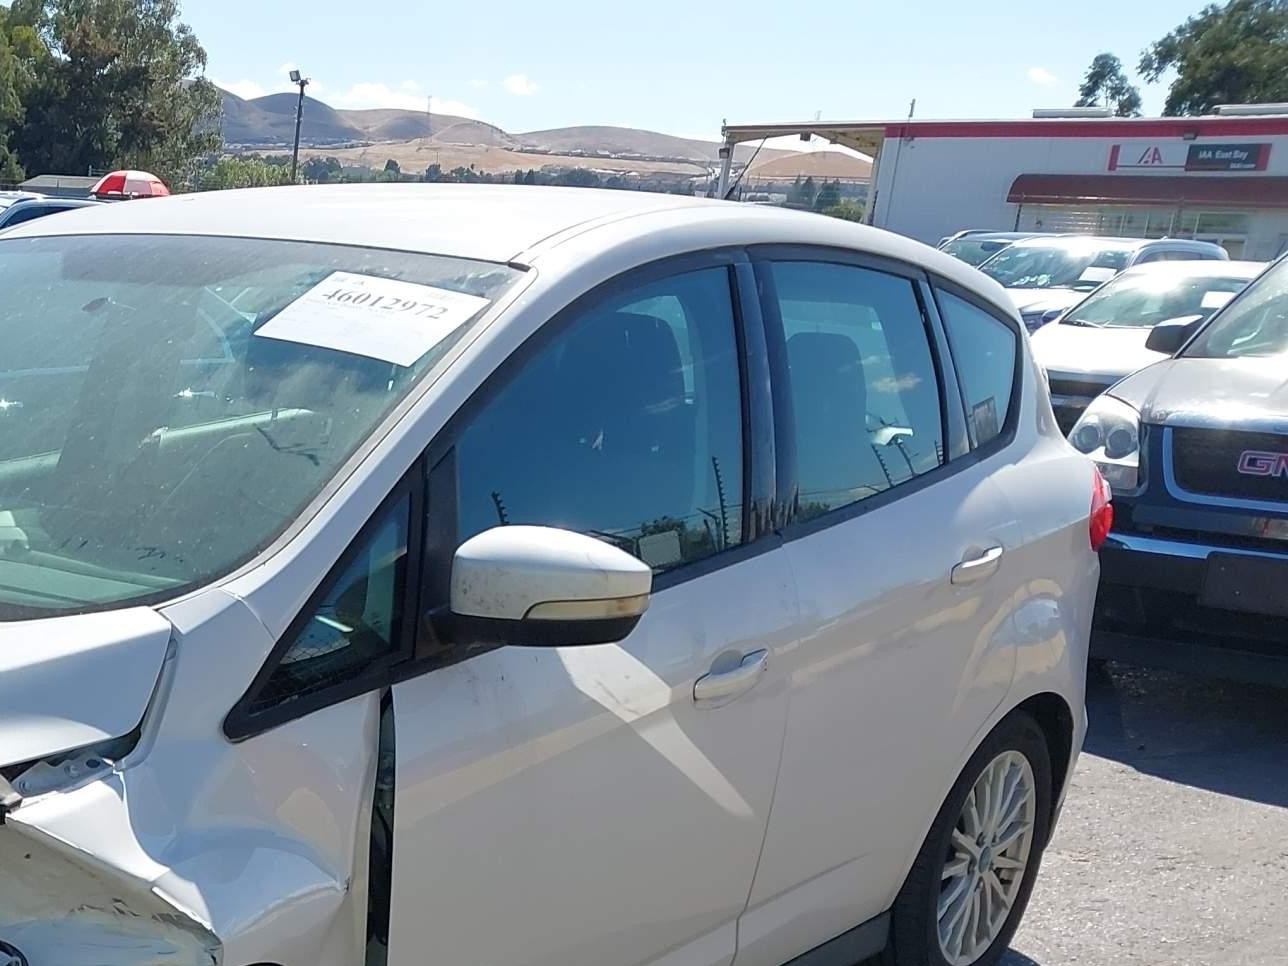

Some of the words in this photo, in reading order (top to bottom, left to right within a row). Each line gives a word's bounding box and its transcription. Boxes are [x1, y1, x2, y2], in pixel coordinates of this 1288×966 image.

[1215, 149, 1232, 159] East
[1233, 149, 1249, 160] Bay
[322, 287, 448, 320] 46012972
